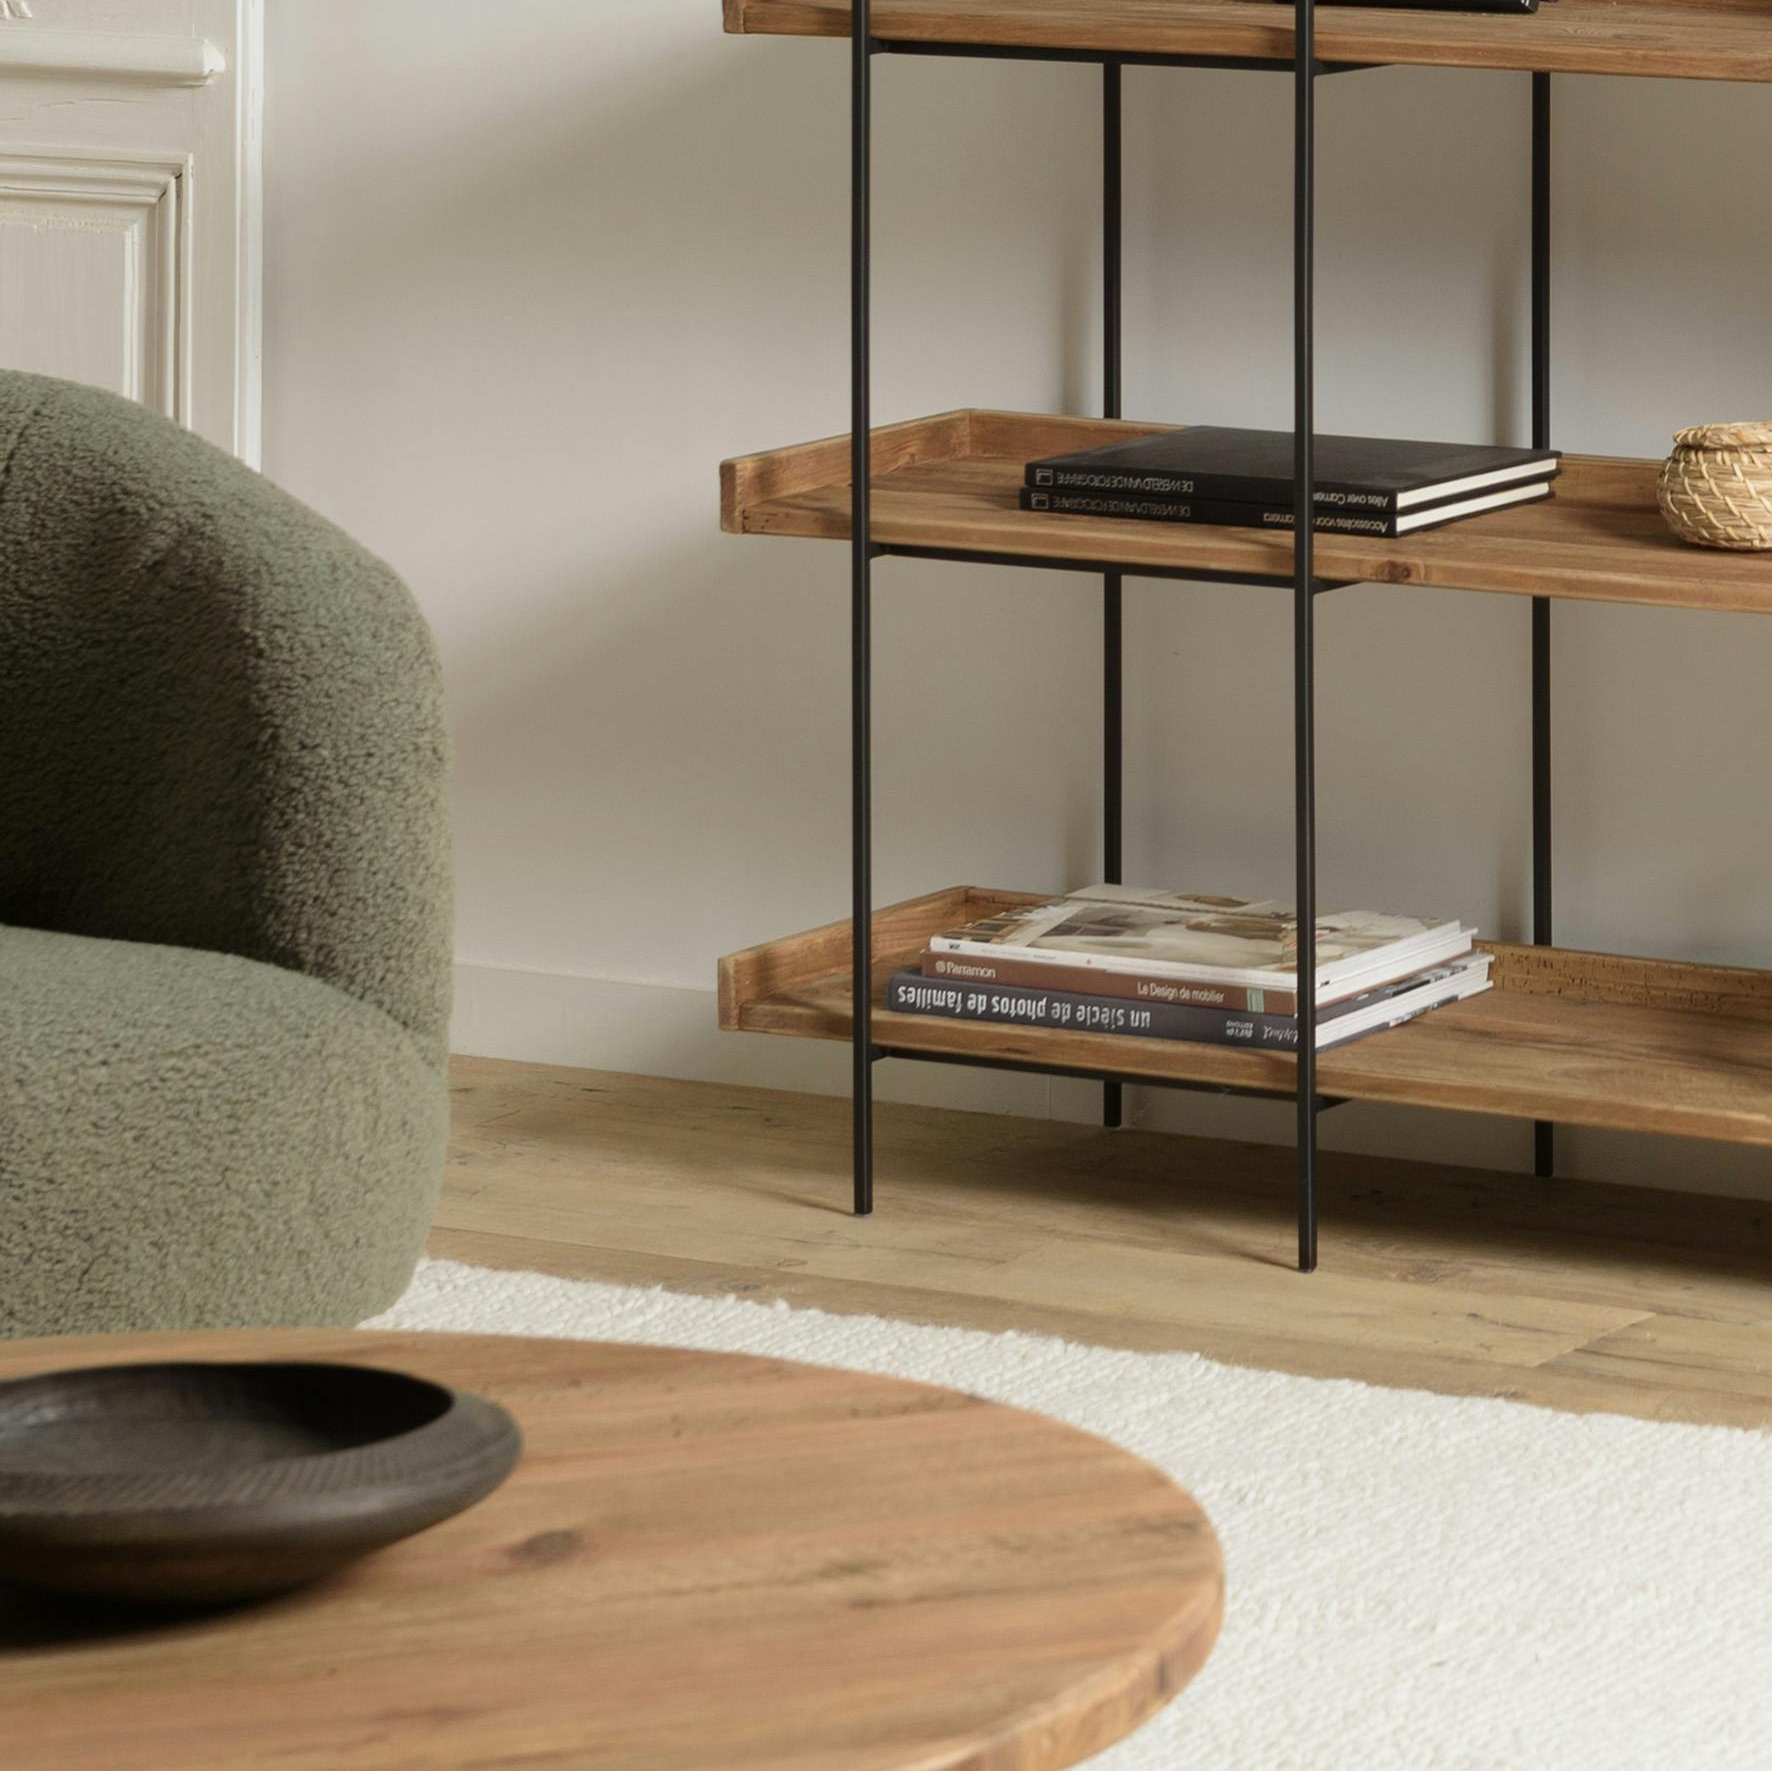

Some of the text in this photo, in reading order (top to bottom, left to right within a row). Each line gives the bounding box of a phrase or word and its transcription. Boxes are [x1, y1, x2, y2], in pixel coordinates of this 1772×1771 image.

[946, 961, 996, 978] Parramon
[1136, 981, 1225, 1004] Le Design de mobilier
[897, 985, 1151, 1030] un siècle de photos de familles
